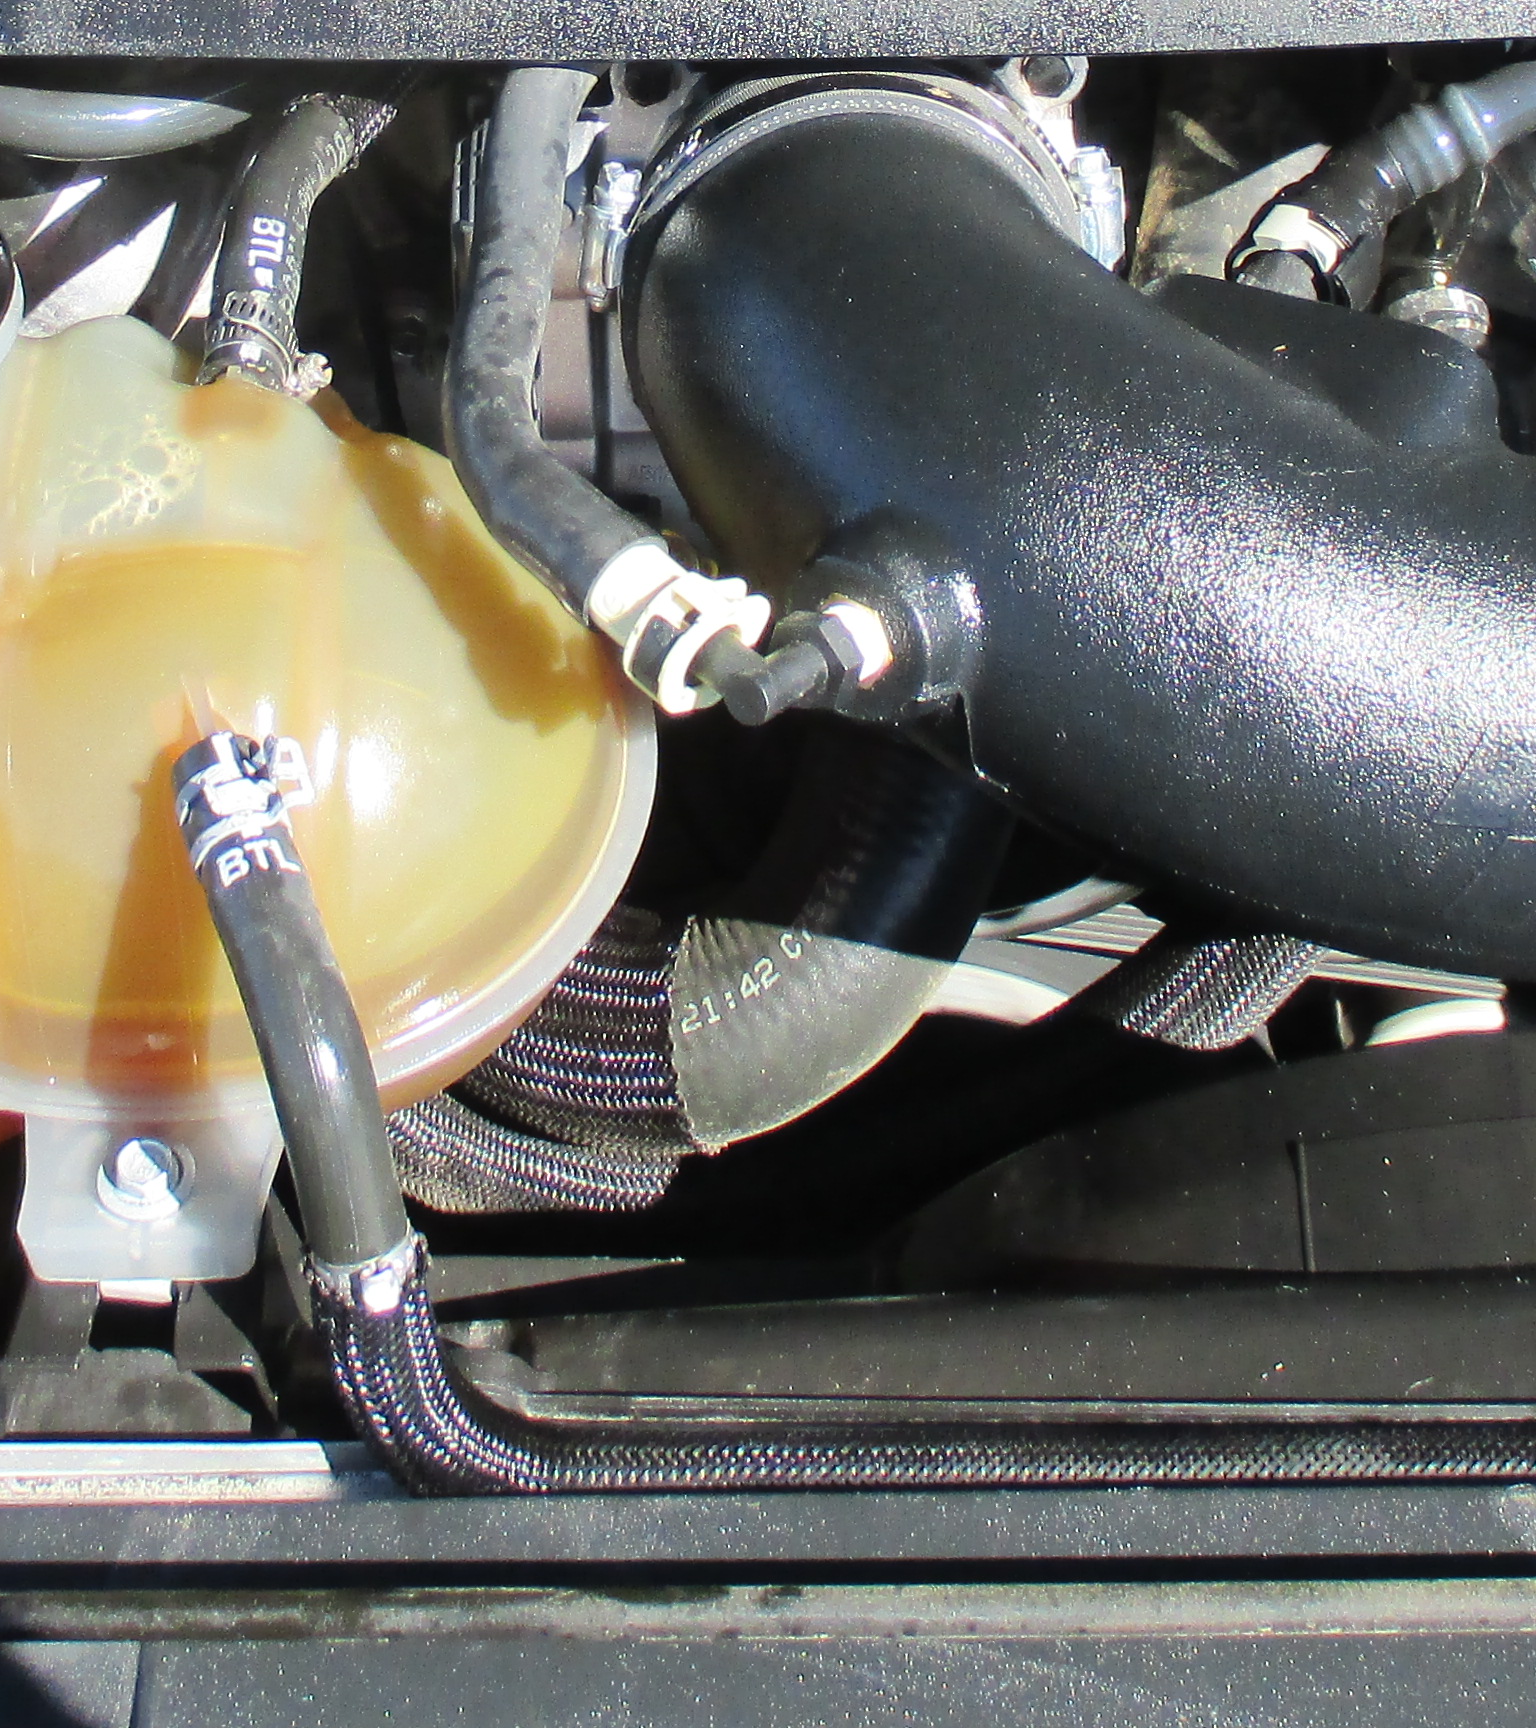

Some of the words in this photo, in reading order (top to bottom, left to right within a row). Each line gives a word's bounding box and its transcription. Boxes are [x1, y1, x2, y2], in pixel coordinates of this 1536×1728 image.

[246, 215, 287, 267] BTL
[215, 838, 303, 888] BTL
[680, 957, 782, 1034] 21:42
